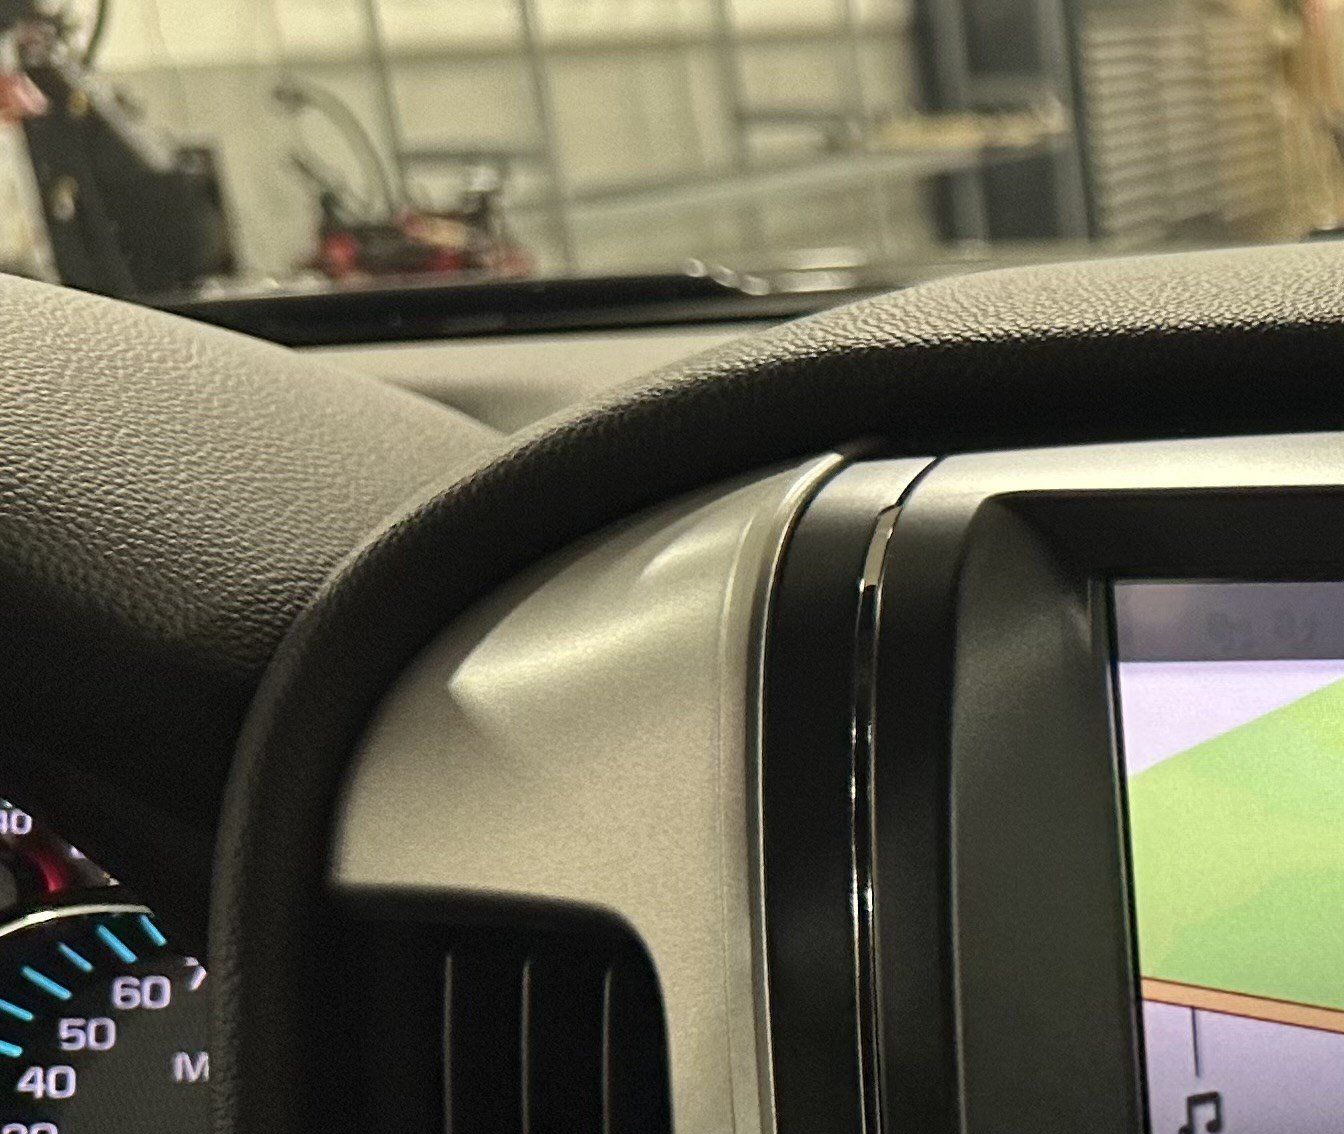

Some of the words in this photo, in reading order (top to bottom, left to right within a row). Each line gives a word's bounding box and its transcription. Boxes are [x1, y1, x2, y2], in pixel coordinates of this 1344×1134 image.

[112, 974, 172, 1011] 60
[58, 1016, 117, 1051] 50
[16, 1064, 77, 1100] 40
